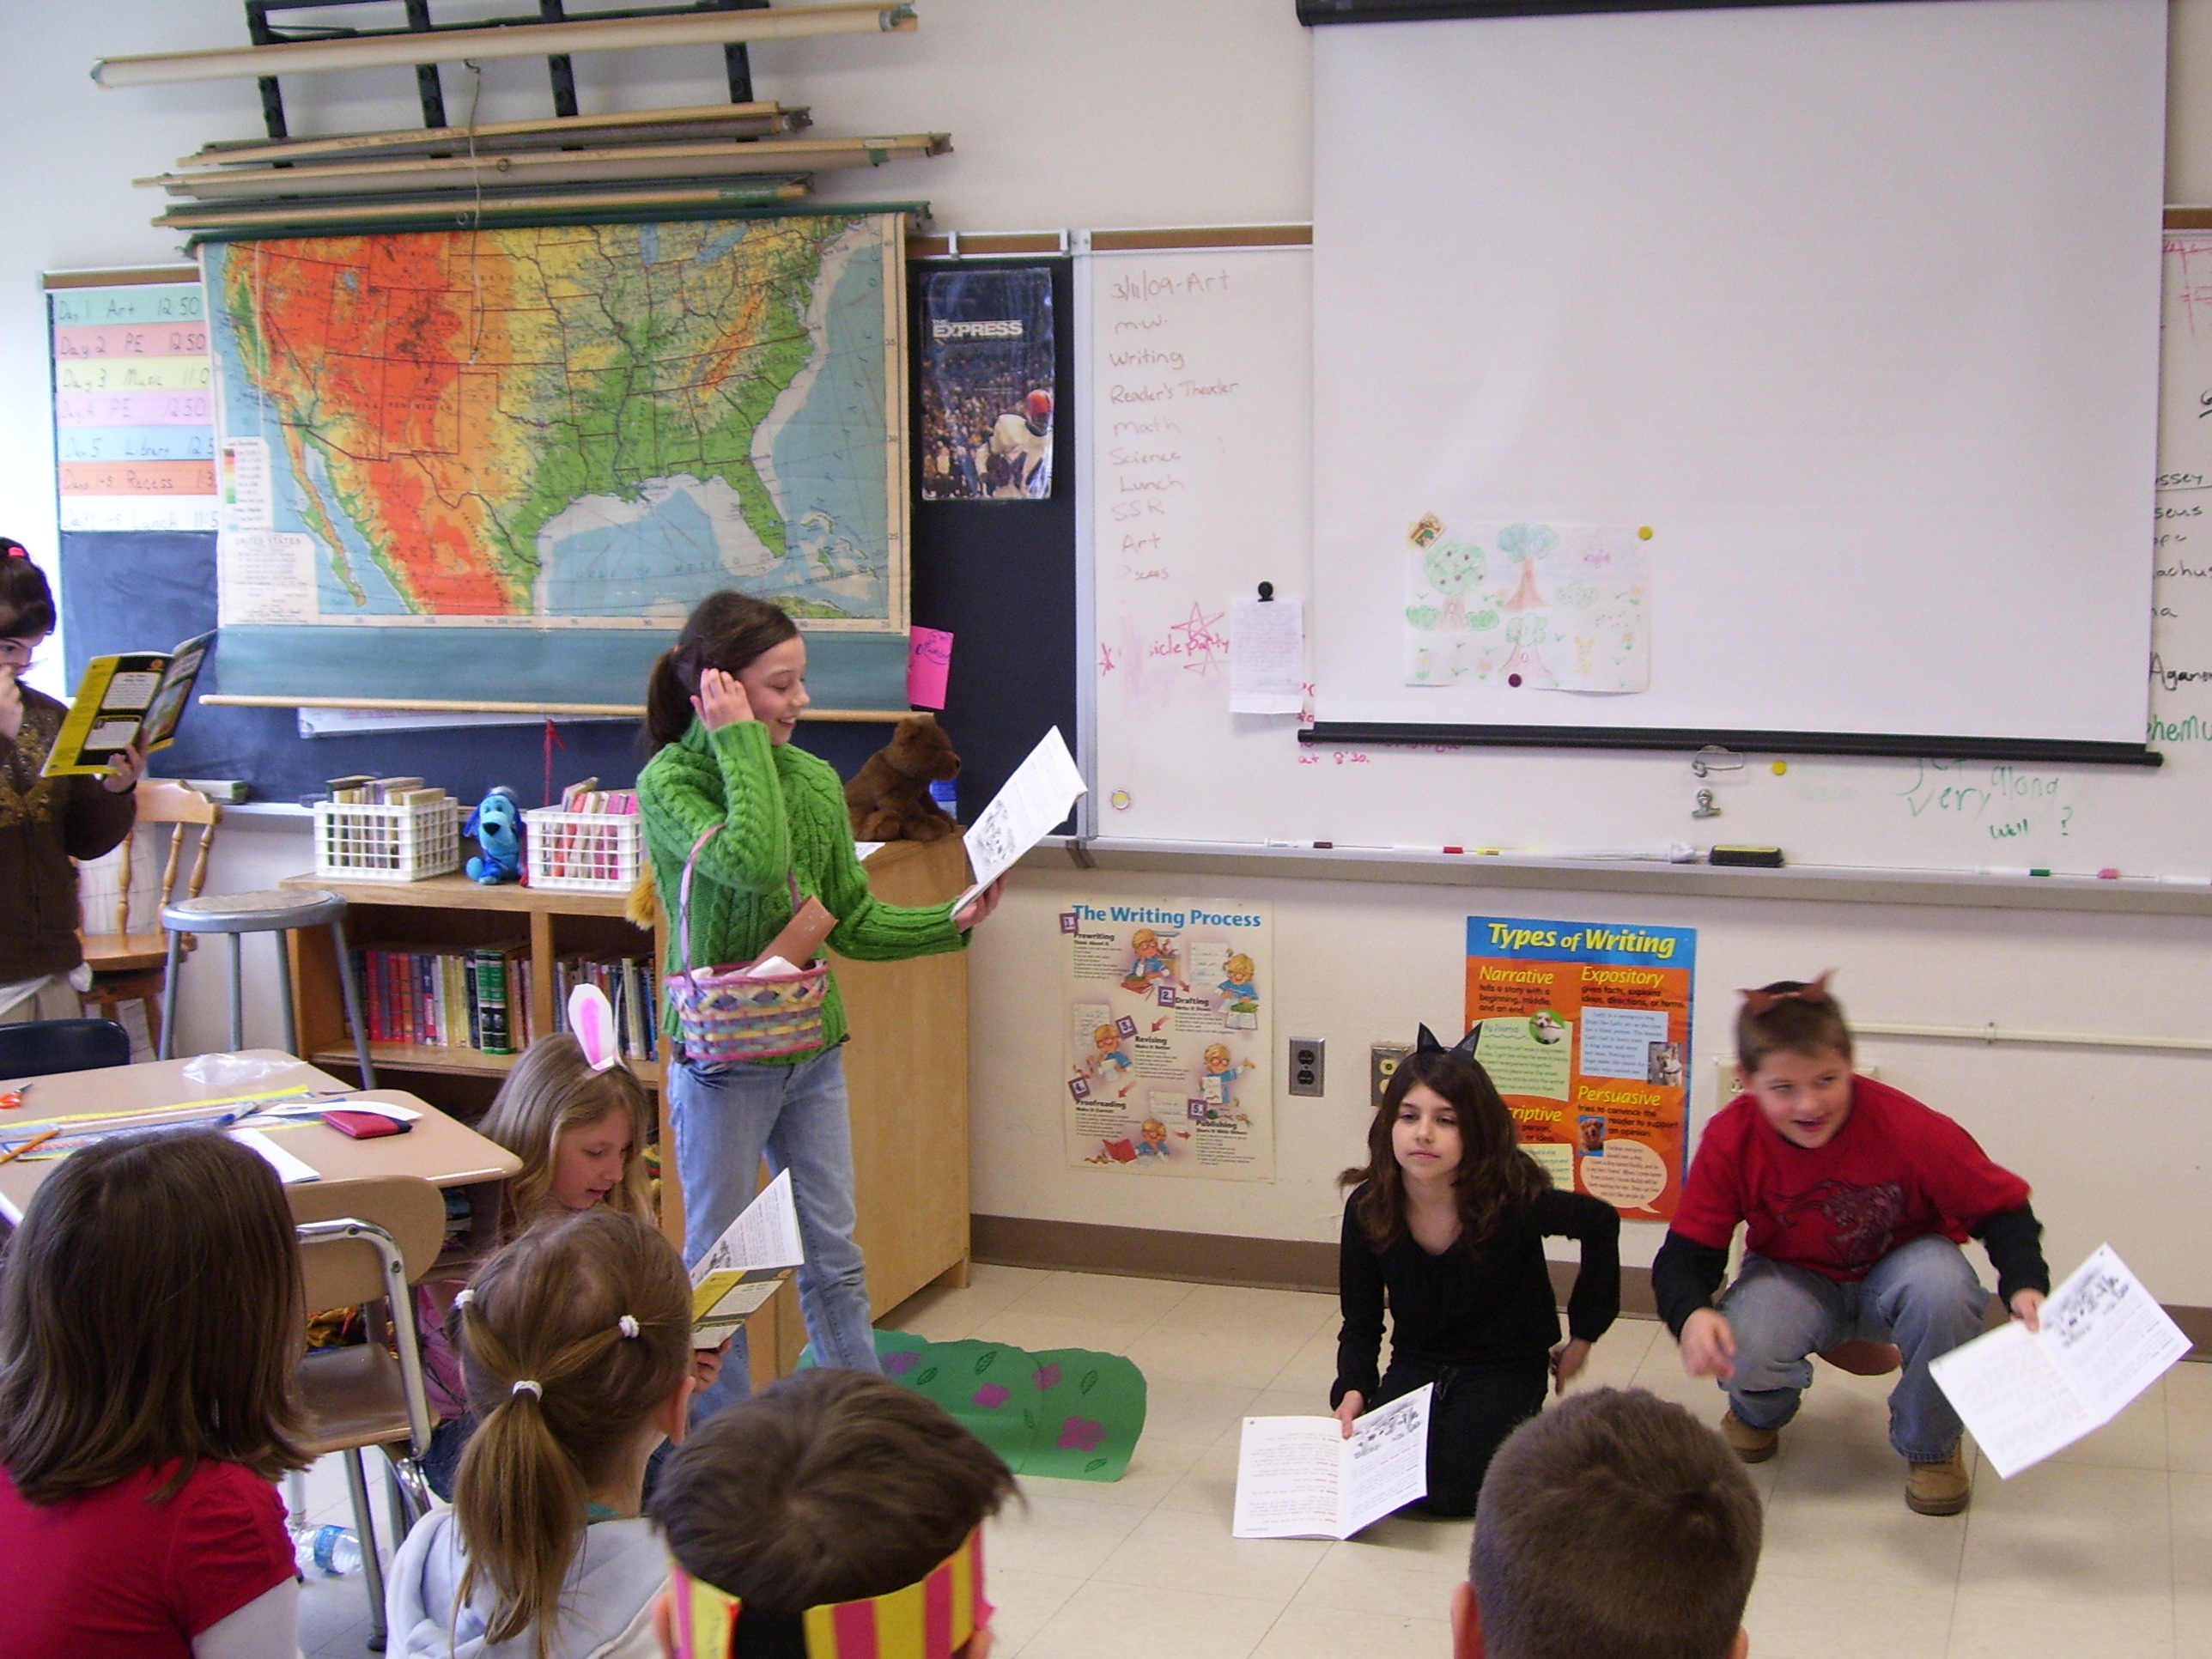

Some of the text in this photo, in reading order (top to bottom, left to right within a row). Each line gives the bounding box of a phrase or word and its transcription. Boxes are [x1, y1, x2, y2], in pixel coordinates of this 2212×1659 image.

[58, 301, 78, 321] Day
[106, 299, 135, 318] Art
[932, 321, 1024, 338] EXPRESS
[61, 336, 89, 360] Day
[95, 336, 106, 353] 2
[125, 332, 144, 353] PE
[63, 368, 92, 392] Day
[98, 367, 106, 387] 3
[123, 368, 162, 386] Music
[1111, 383, 1174, 404] Reader's
[110, 398, 131, 417] PE
[1109, 447, 1182, 465] Science
[127, 470, 174, 490] Recess
[2154, 473, 2203, 487] ssey
[1121, 532, 1161, 552] Art
[1072, 904, 1262, 928] The Writing Process
[1073, 932, 1115, 942] Prewriting
[1487, 922, 1677, 959] Types of Writing
[1479, 965, 1554, 985] Narrative
[1581, 965, 1665, 989] Expository
[1175, 997, 1210, 1007] Drafting
[1135, 1036, 1168, 1046] Revising
[1075, 1100, 1127, 1111] Proofreading
[1578, 1085, 1662, 1107] Persuasive
[1195, 1120, 1238, 1131] Publishing
